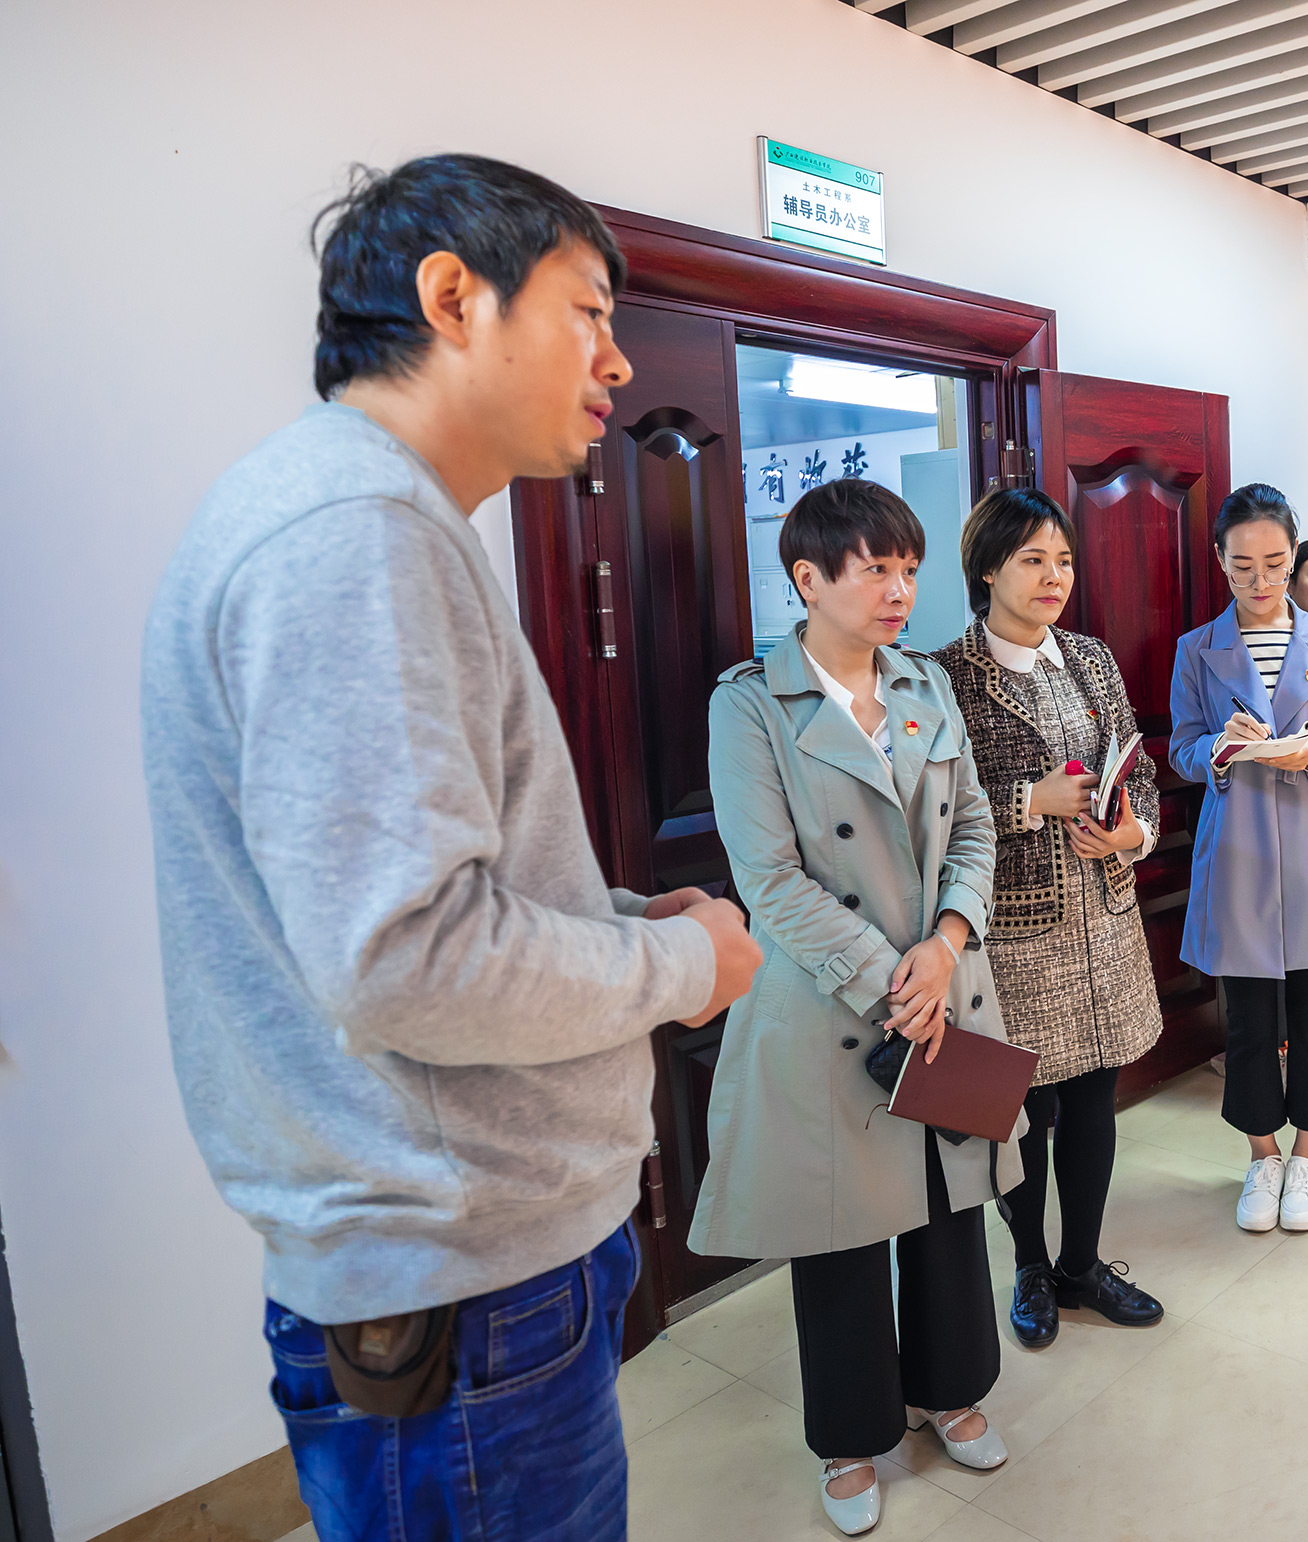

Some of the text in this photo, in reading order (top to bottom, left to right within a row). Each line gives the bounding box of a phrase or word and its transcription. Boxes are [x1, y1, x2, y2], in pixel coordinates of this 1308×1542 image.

[855, 171, 876, 187] 907
[802, 181, 852, 203] 土木工程系
[783, 194, 871, 235] 辅导员办公室
